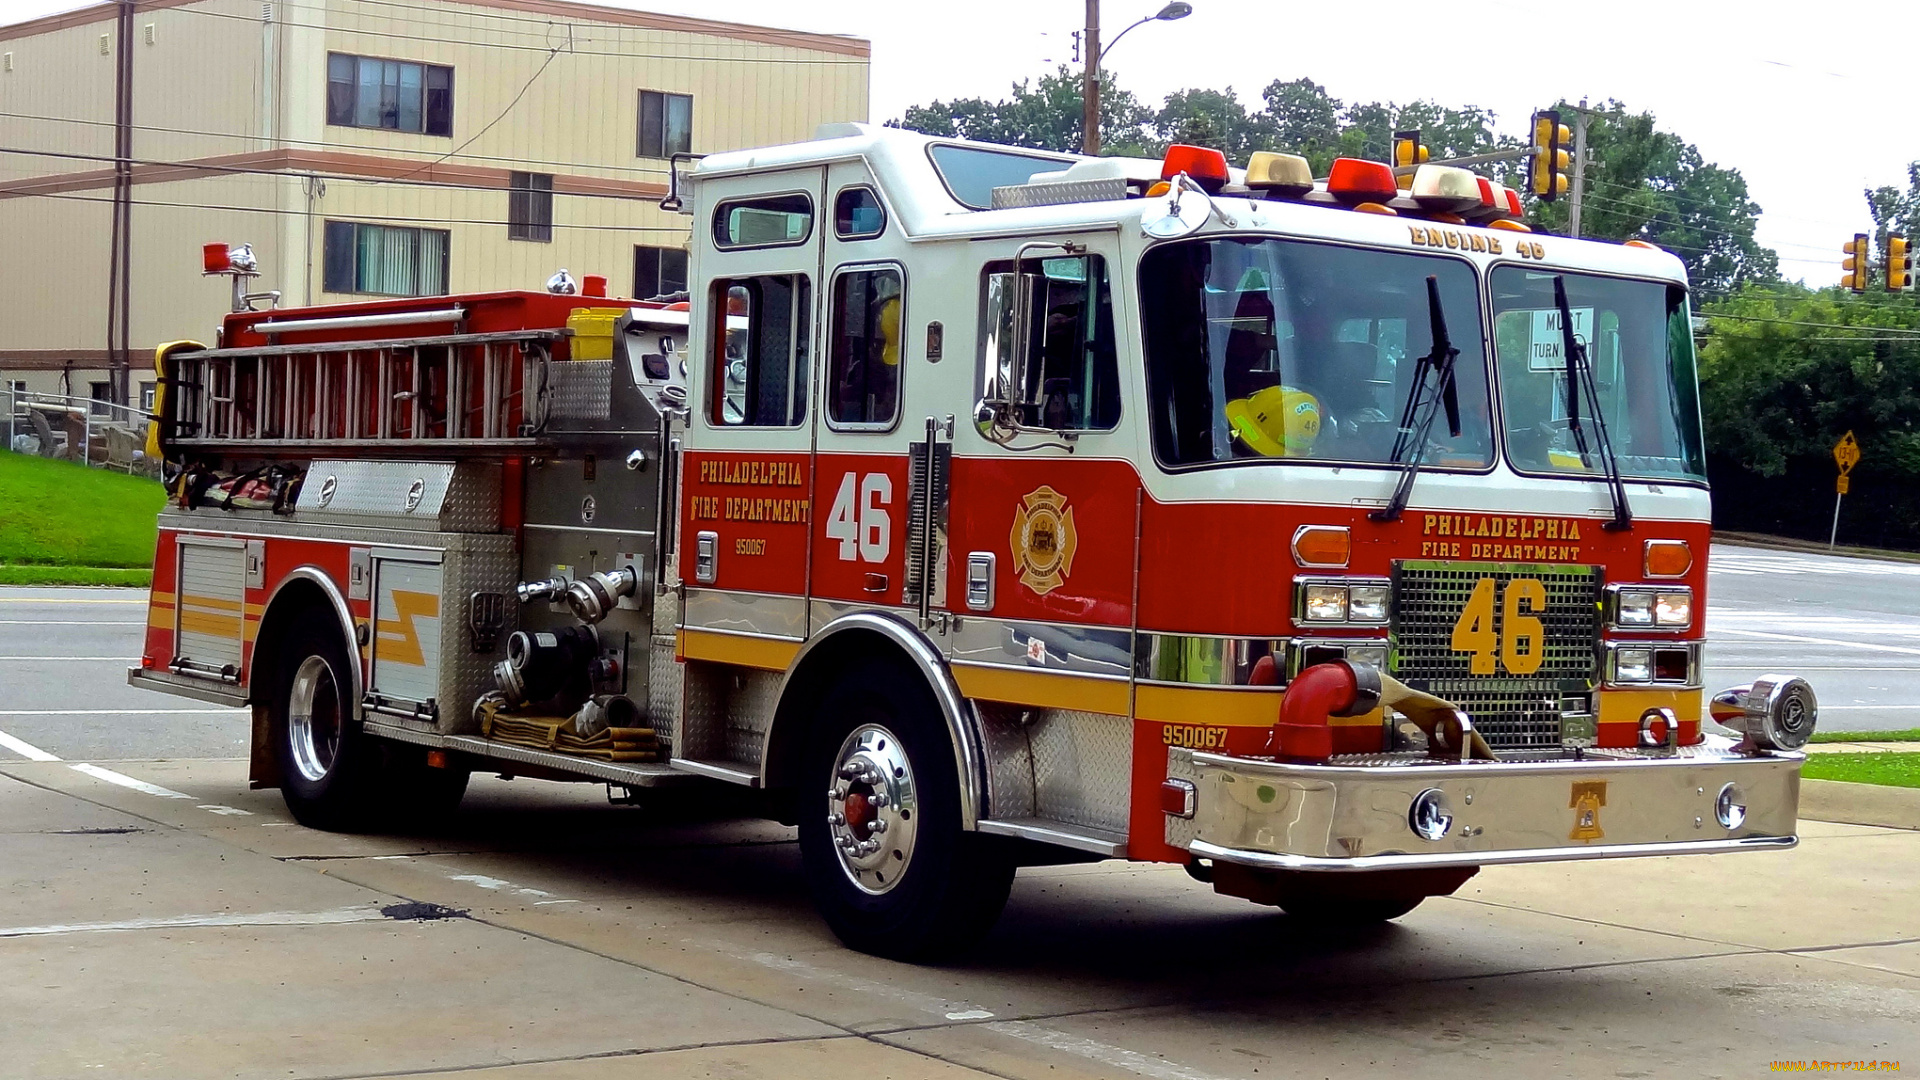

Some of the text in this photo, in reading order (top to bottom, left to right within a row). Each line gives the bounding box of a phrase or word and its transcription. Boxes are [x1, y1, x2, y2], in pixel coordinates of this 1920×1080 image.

[1408, 226, 1545, 260] ENGINE 46
[1546, 312, 1582, 331] MUT
[1533, 342, 1559, 358] TURN
[701, 460, 802, 485] PHILADELPHIA
[690, 495, 810, 523] FIRE DEPARTMENT
[826, 471, 893, 564] 46
[1423, 514, 1581, 540] PHILADELPHIA
[735, 538, 767, 556] 950067
[1421, 541, 1580, 561] FIRE DEPARTMENT
[1451, 577, 1547, 675] 46
[1162, 724, 1228, 748] 950067
